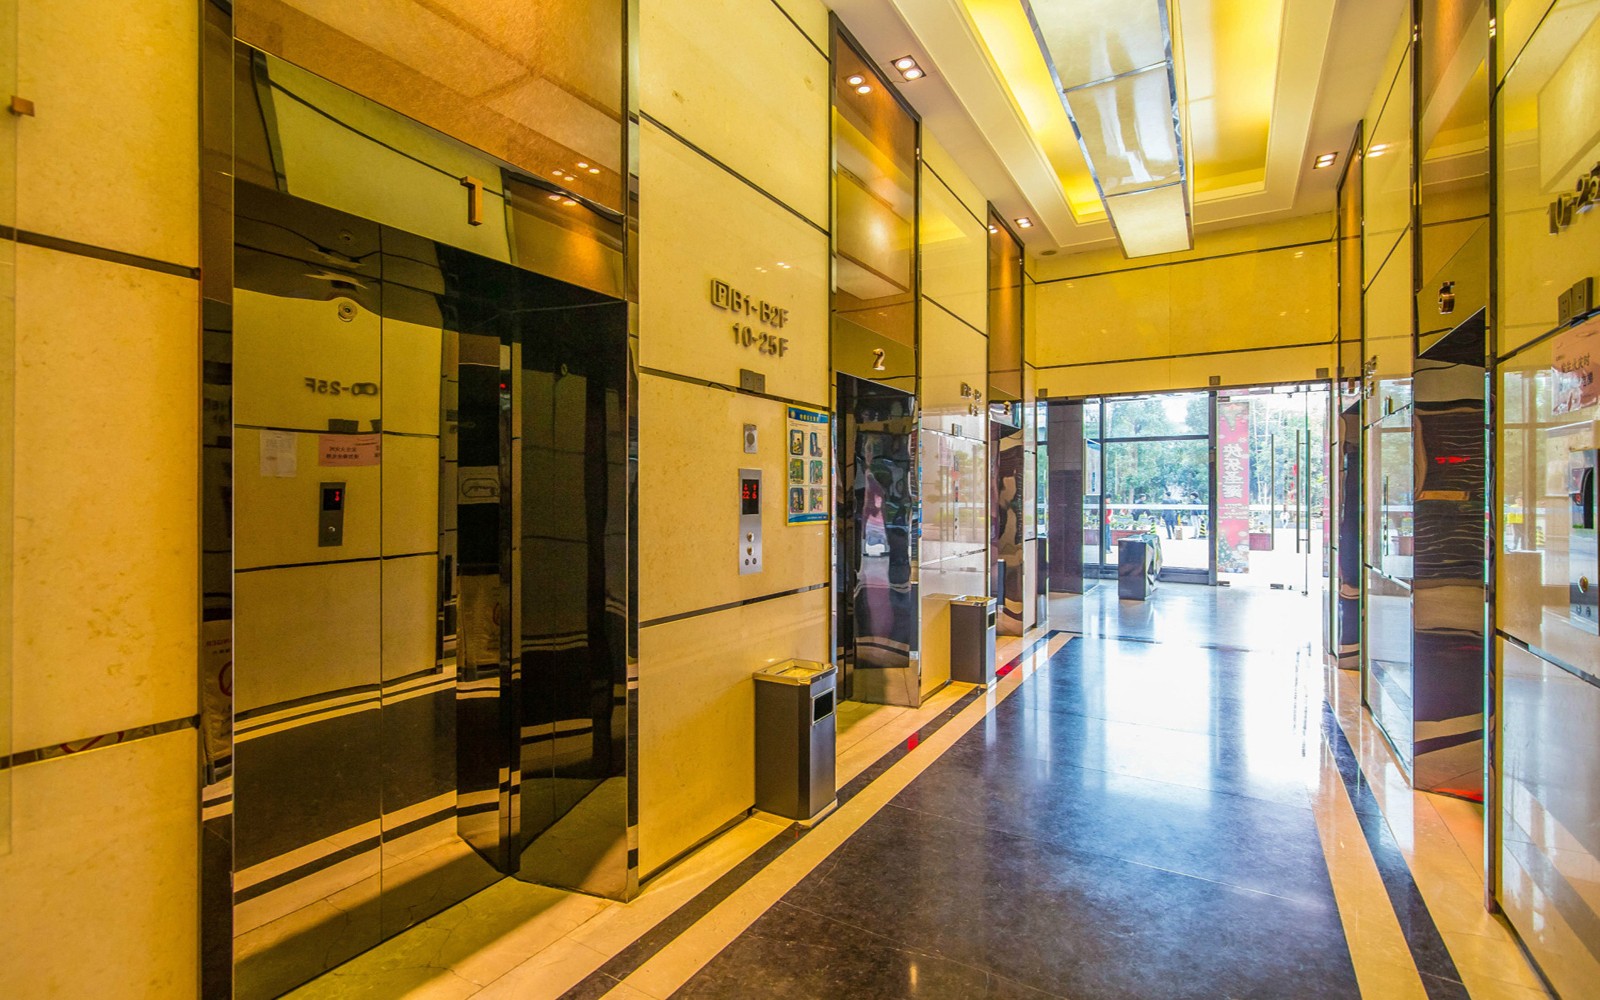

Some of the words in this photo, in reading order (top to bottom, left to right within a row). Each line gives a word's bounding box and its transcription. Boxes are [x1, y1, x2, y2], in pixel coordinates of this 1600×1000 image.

[460, 176, 483, 226] 1
[731, 288, 789, 328] B1-B2F
[732, 323, 789, 357] 10-25F
[873, 348, 886, 371] 2
